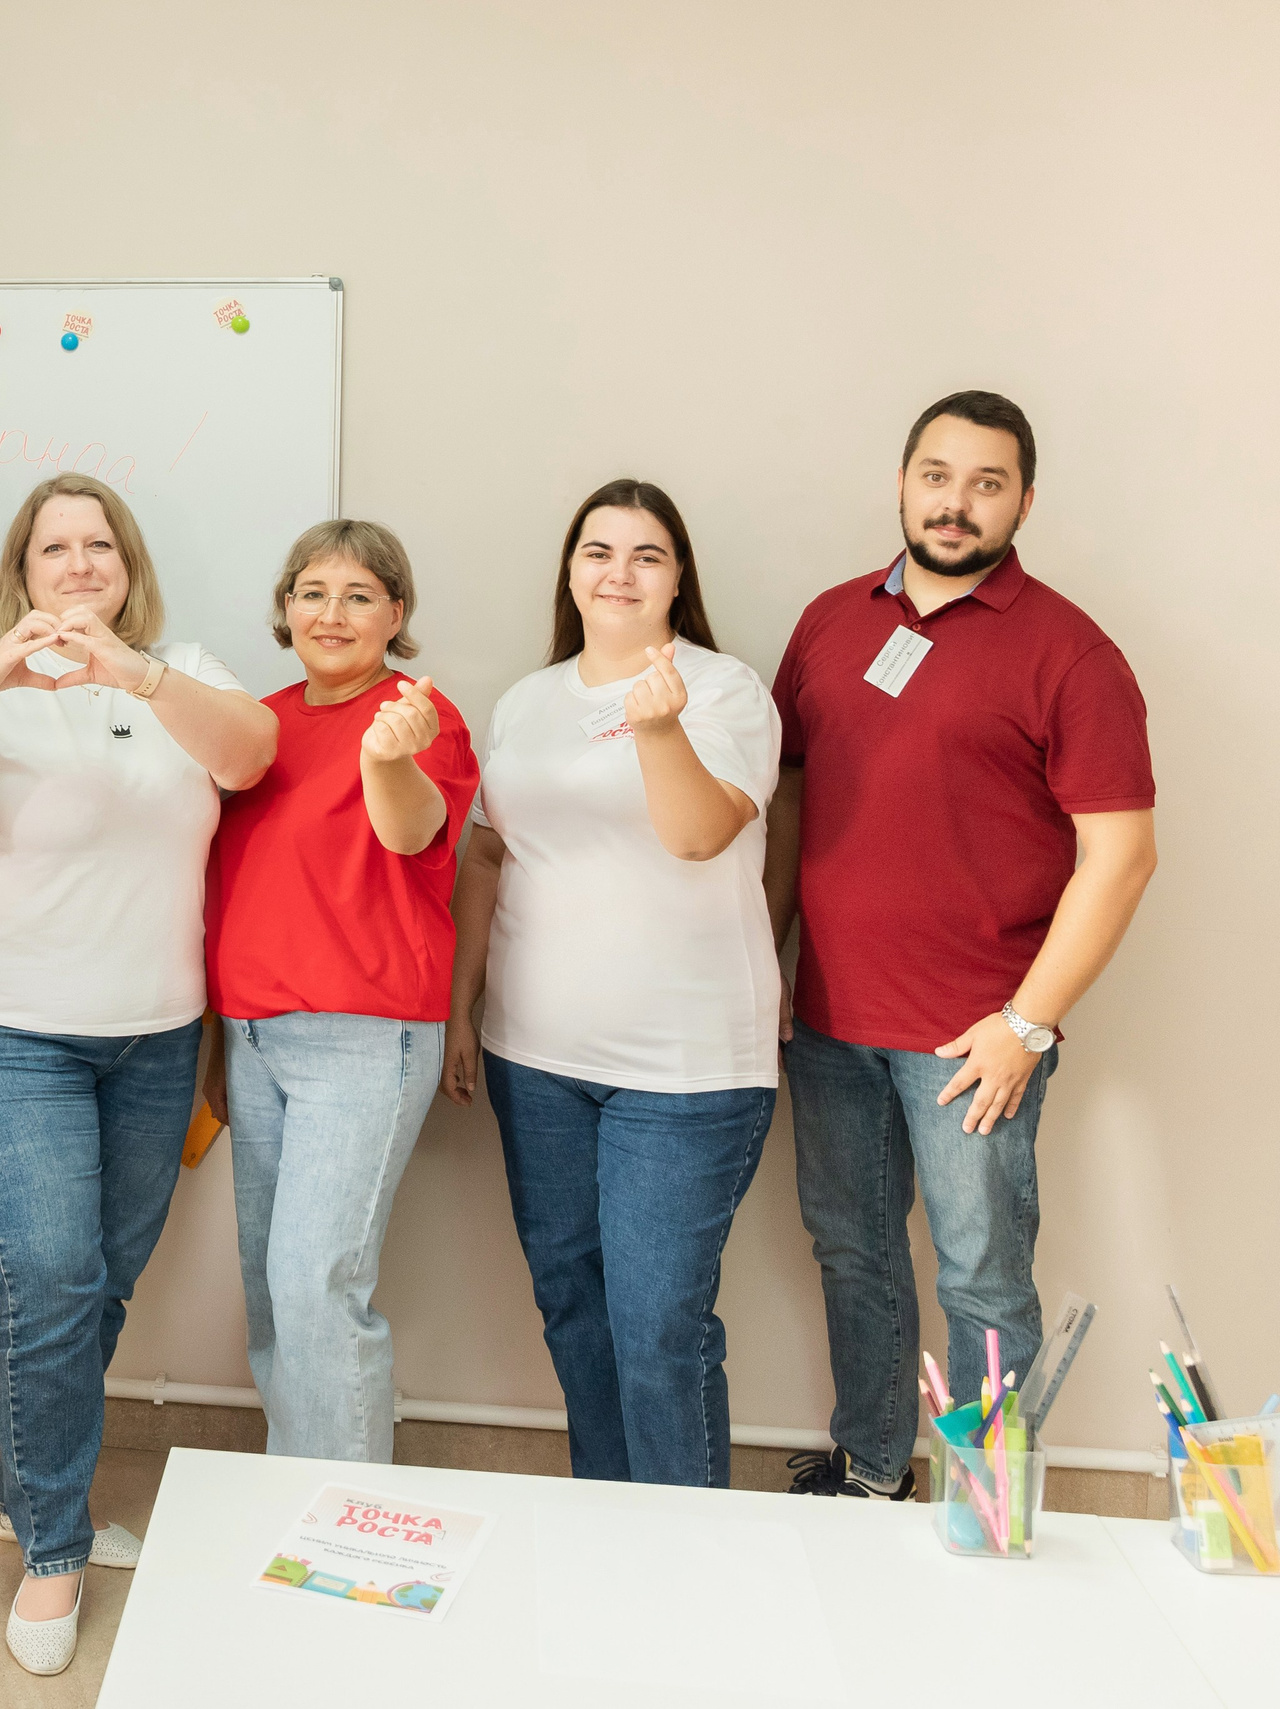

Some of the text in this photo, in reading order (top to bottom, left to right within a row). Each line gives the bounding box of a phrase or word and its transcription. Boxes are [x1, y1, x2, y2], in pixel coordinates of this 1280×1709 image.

[65, 313, 92, 325] ТОЧКА
[213, 299, 240, 318] ТОЧКА
[342, 1503, 443, 1530] ТОЧКА
[336, 1515, 434, 1546] РОСТА
